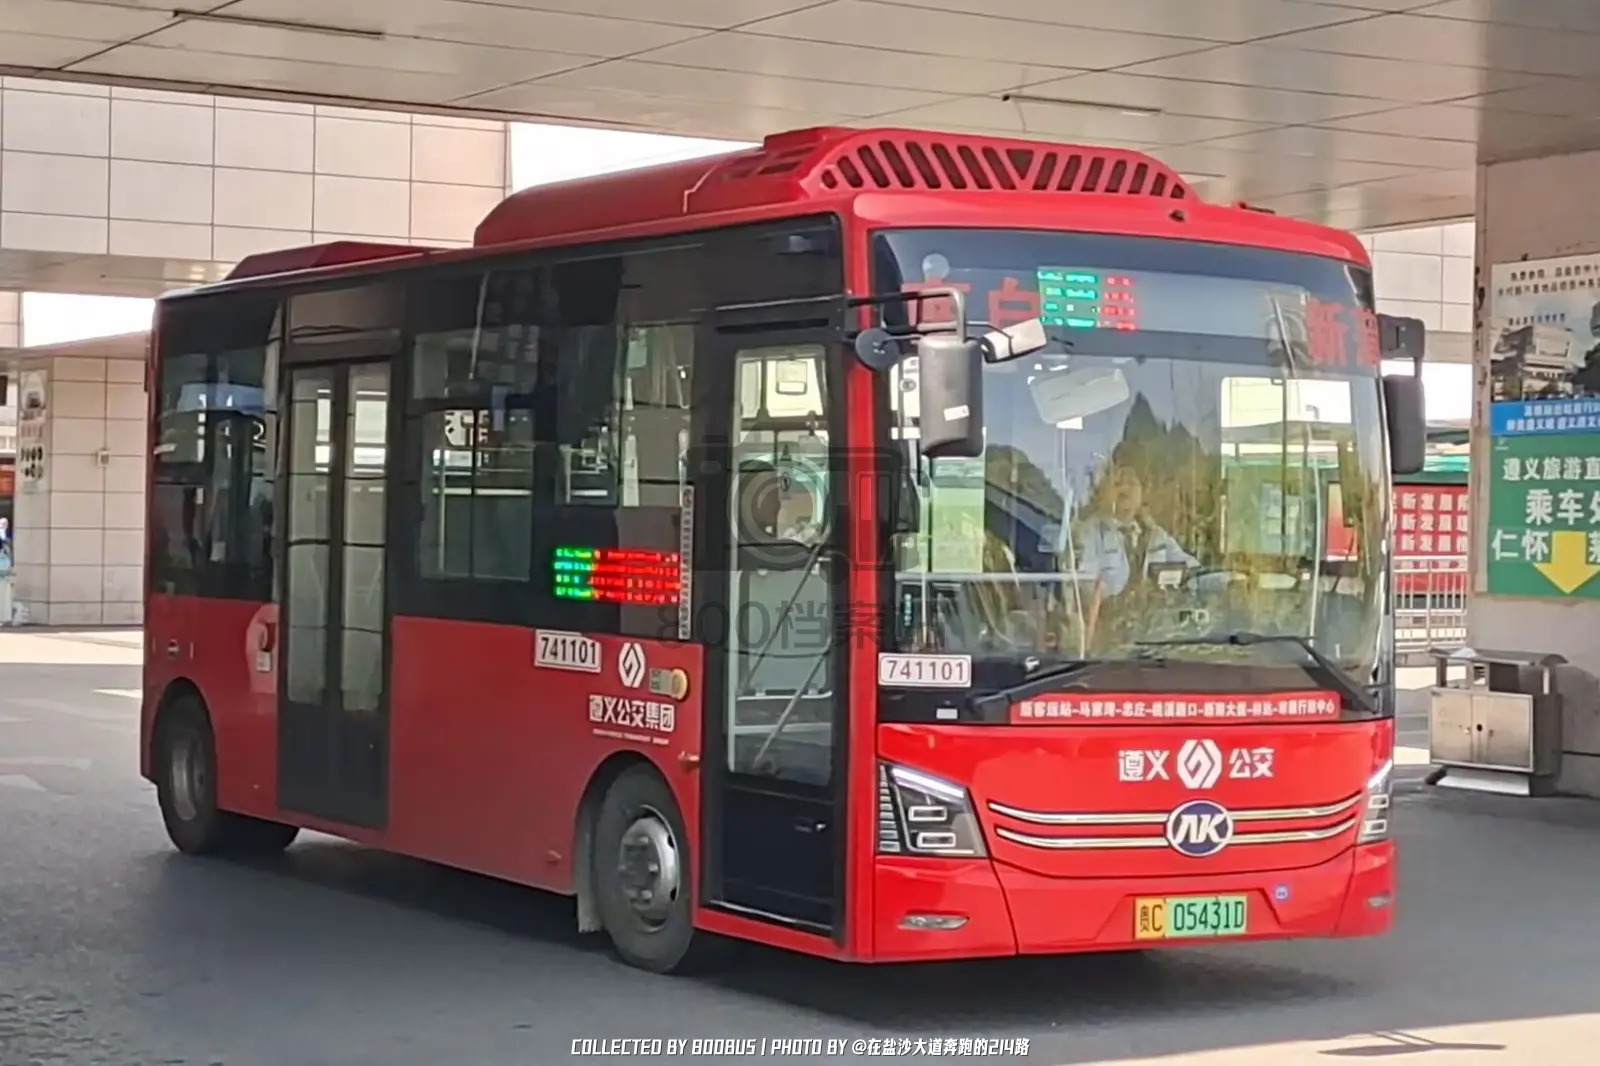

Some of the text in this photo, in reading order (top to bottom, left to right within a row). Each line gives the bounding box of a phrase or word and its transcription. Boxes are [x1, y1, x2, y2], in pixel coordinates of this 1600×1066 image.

[1491, 528, 1549, 561] 仁怀
[541, 636, 596, 665] 741101
[887, 660, 964, 681] 741101
[589, 694, 675, 733] 遵义公交集团
[1118, 747, 1275, 782] 遵义 公交
